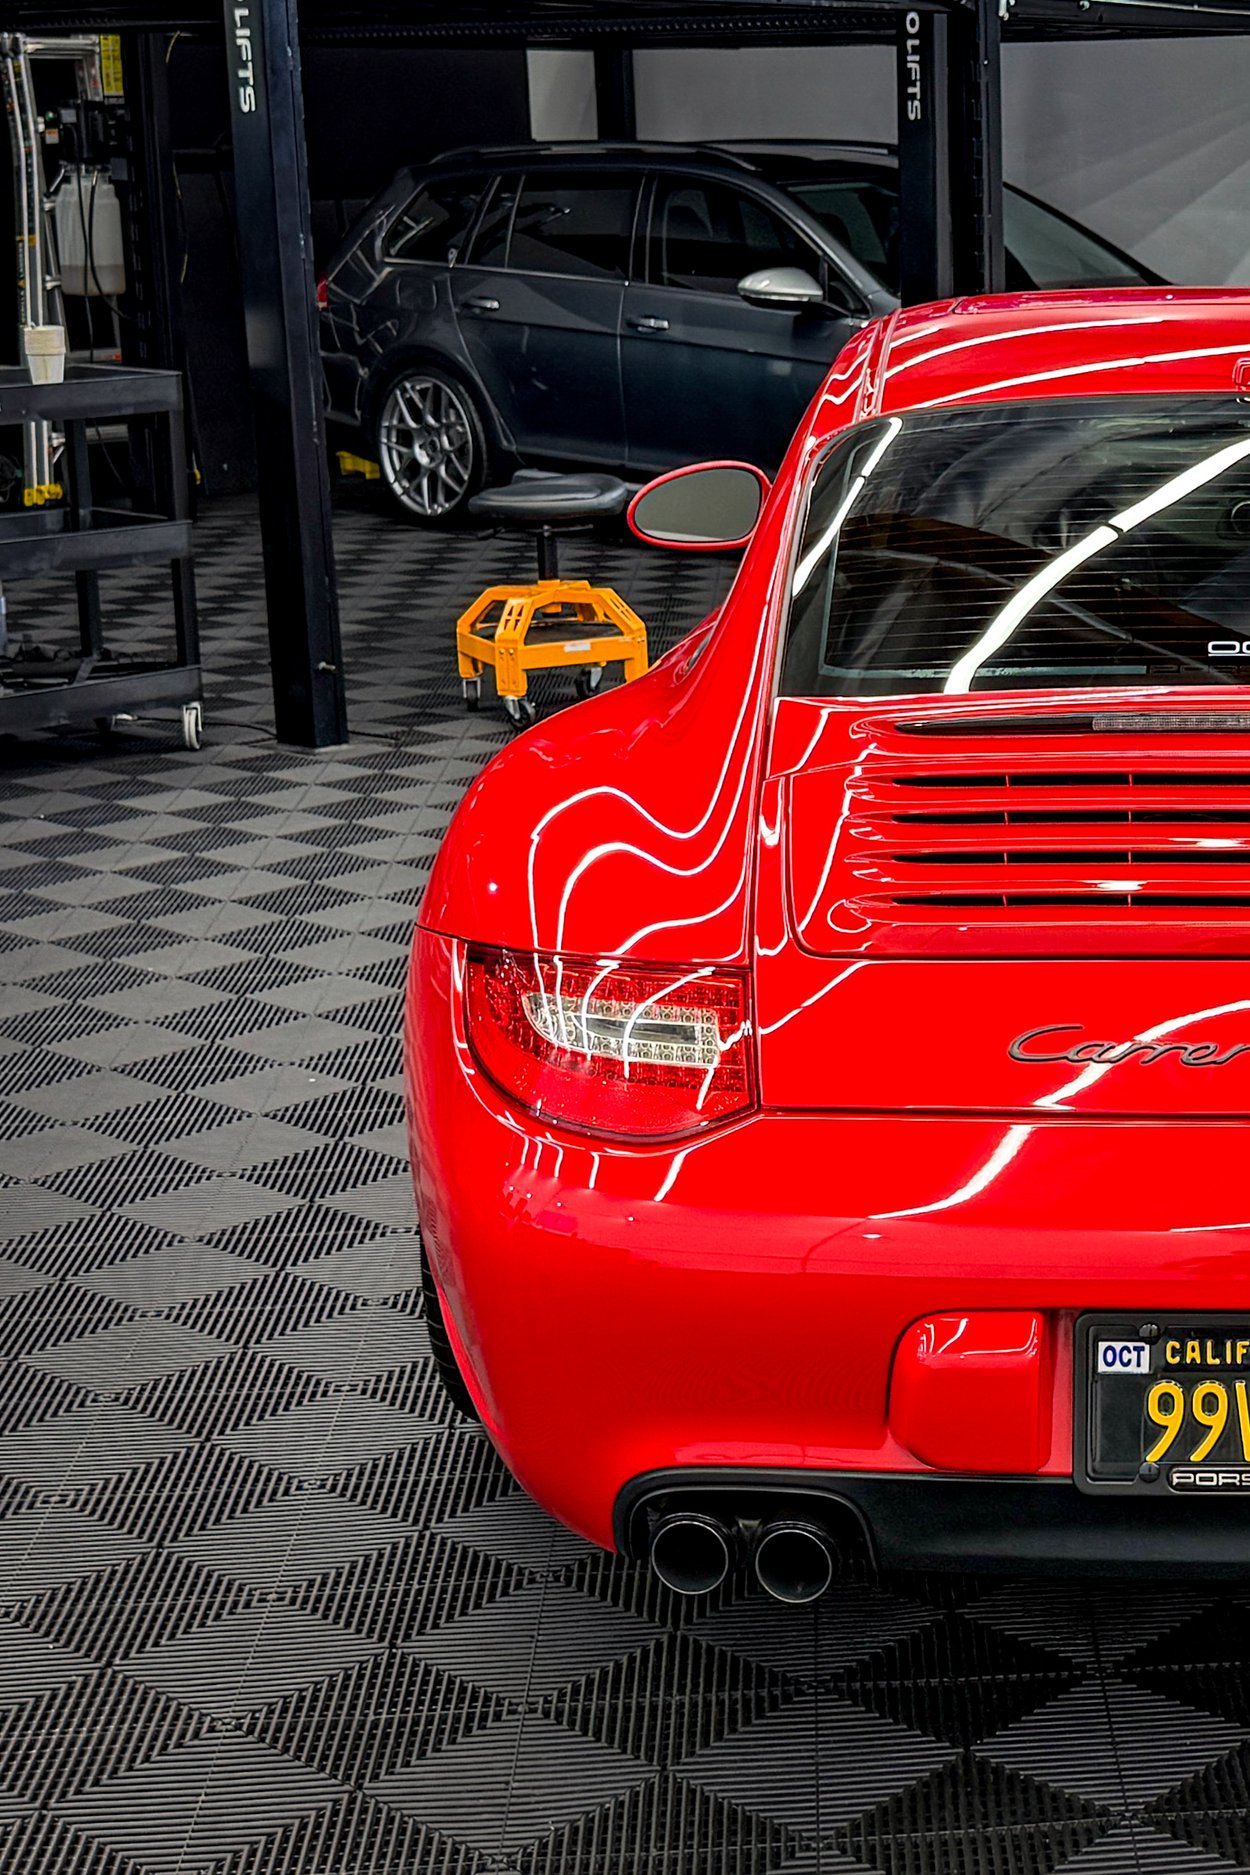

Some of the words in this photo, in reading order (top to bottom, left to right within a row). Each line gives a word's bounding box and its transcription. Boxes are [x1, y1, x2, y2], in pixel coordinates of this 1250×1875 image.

[234, 7, 256, 113] LIFTS
[906, 39, 921, 121] LIFTS
[1102, 1345, 1146, 1368] OCT
